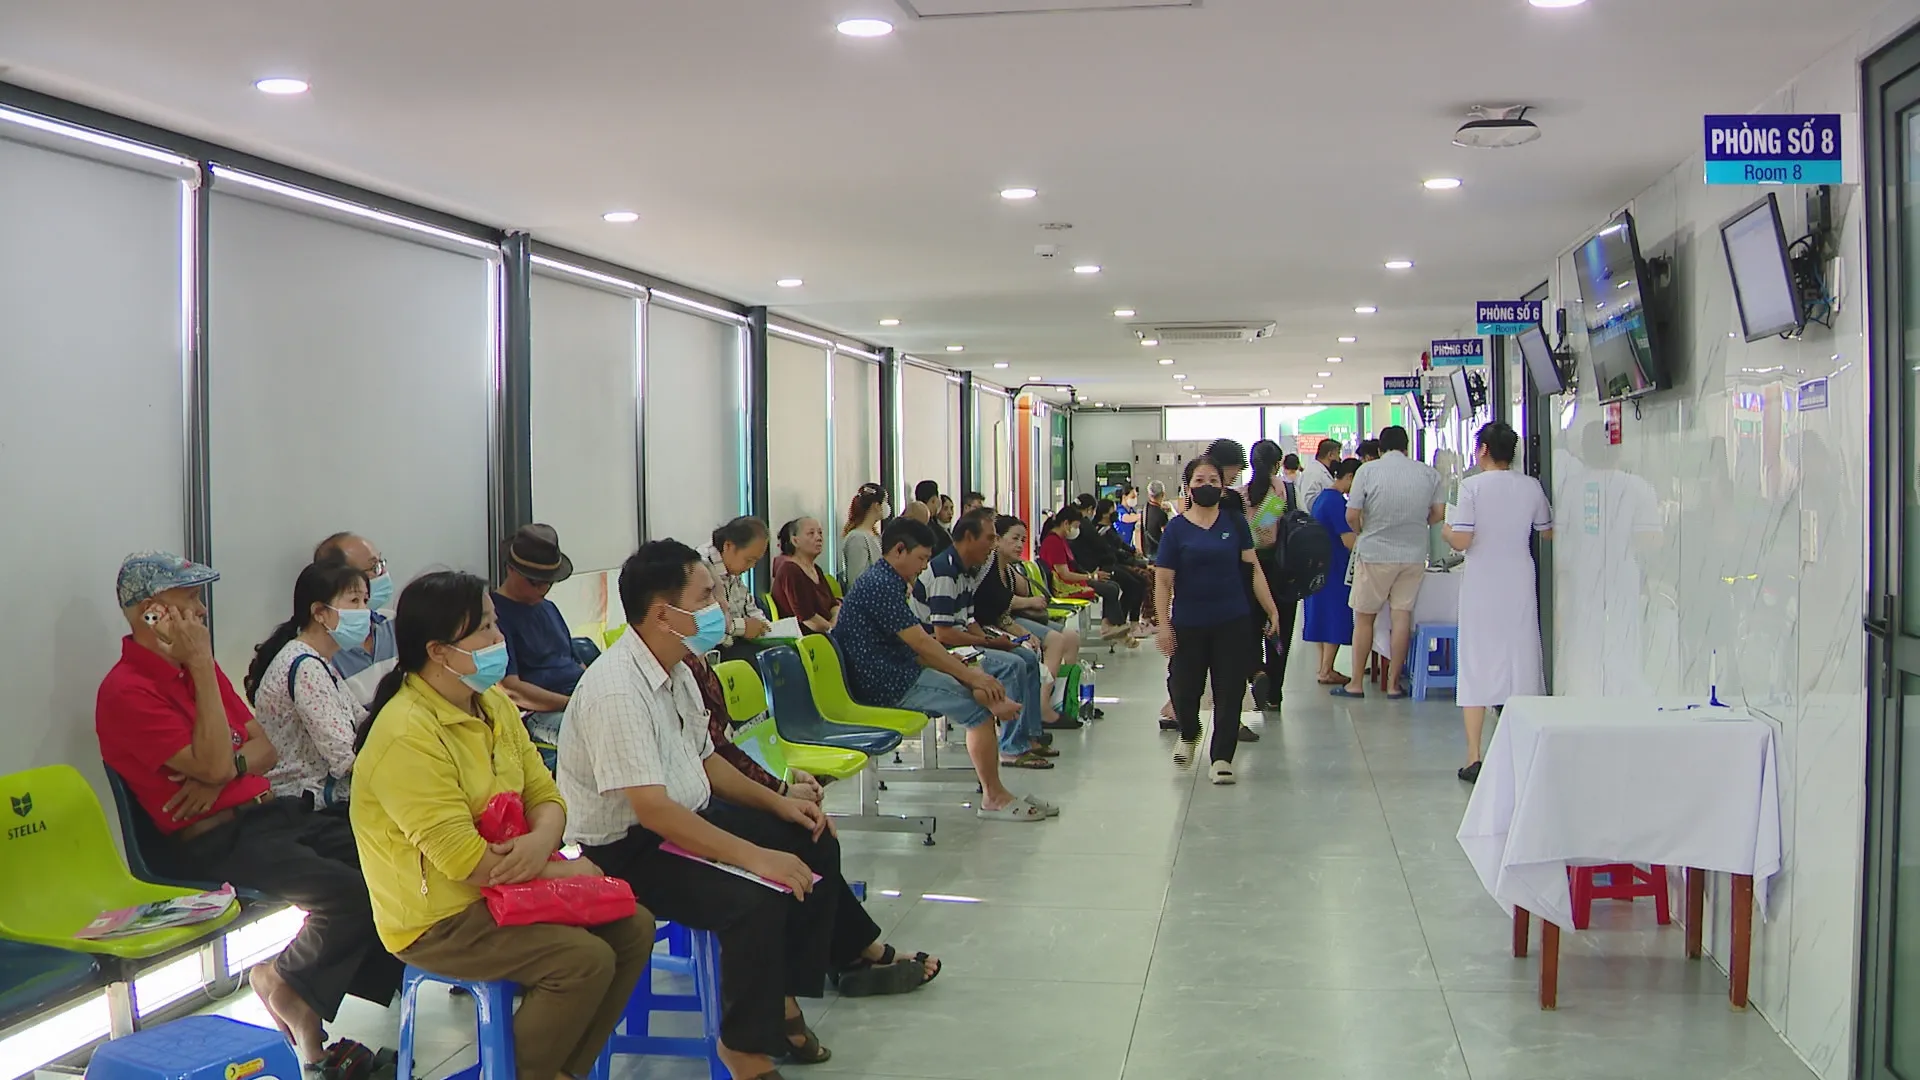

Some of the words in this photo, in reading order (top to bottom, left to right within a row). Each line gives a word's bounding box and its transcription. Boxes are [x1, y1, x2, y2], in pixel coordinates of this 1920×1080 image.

[1711, 122, 1781, 154] PHÒNG
[1787, 118, 1815, 154] SỐ
[1821, 128, 1834, 154] 8
[1744, 164, 1787, 180] Room
[1793, 164, 1802, 180] 8
[1479, 304, 1514, 320] PHÒNG
[1516, 302, 1530, 320] SỐ
[1532, 307, 1539, 320] 6
[1433, 342, 1461, 356] PHÒNG
[1462, 340, 1474, 355] SỐ
[1474, 344, 1481, 355] 4
[1414, 380, 1419, 388] 2
[7, 820, 47, 840] STELLA
